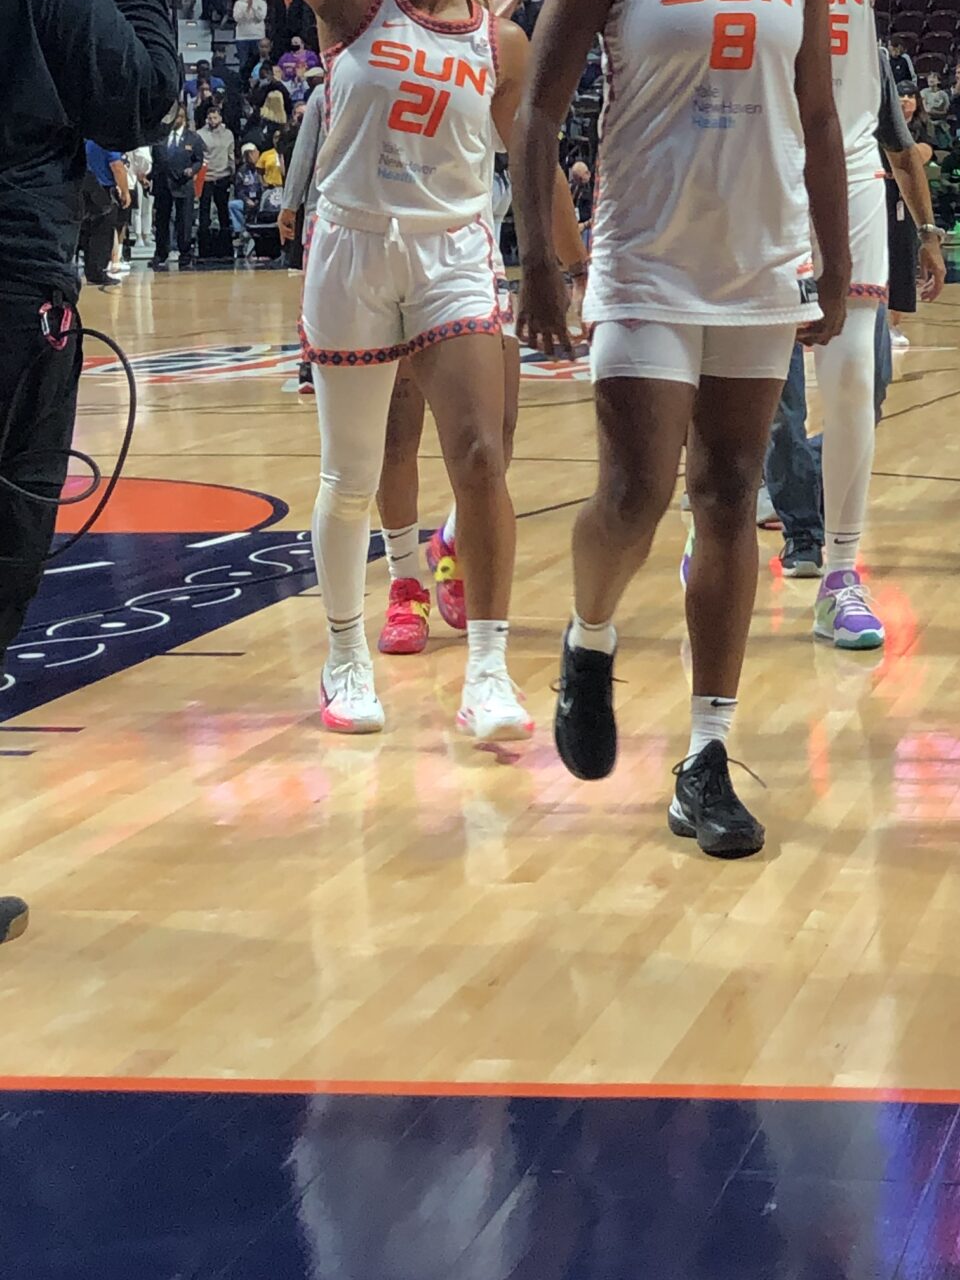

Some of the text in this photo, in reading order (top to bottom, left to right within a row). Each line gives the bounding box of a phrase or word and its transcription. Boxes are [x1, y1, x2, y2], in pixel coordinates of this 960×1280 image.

[368, 40, 488, 96] SUN
[709, 12, 756, 70] 8
[387, 80, 451, 138] 21
